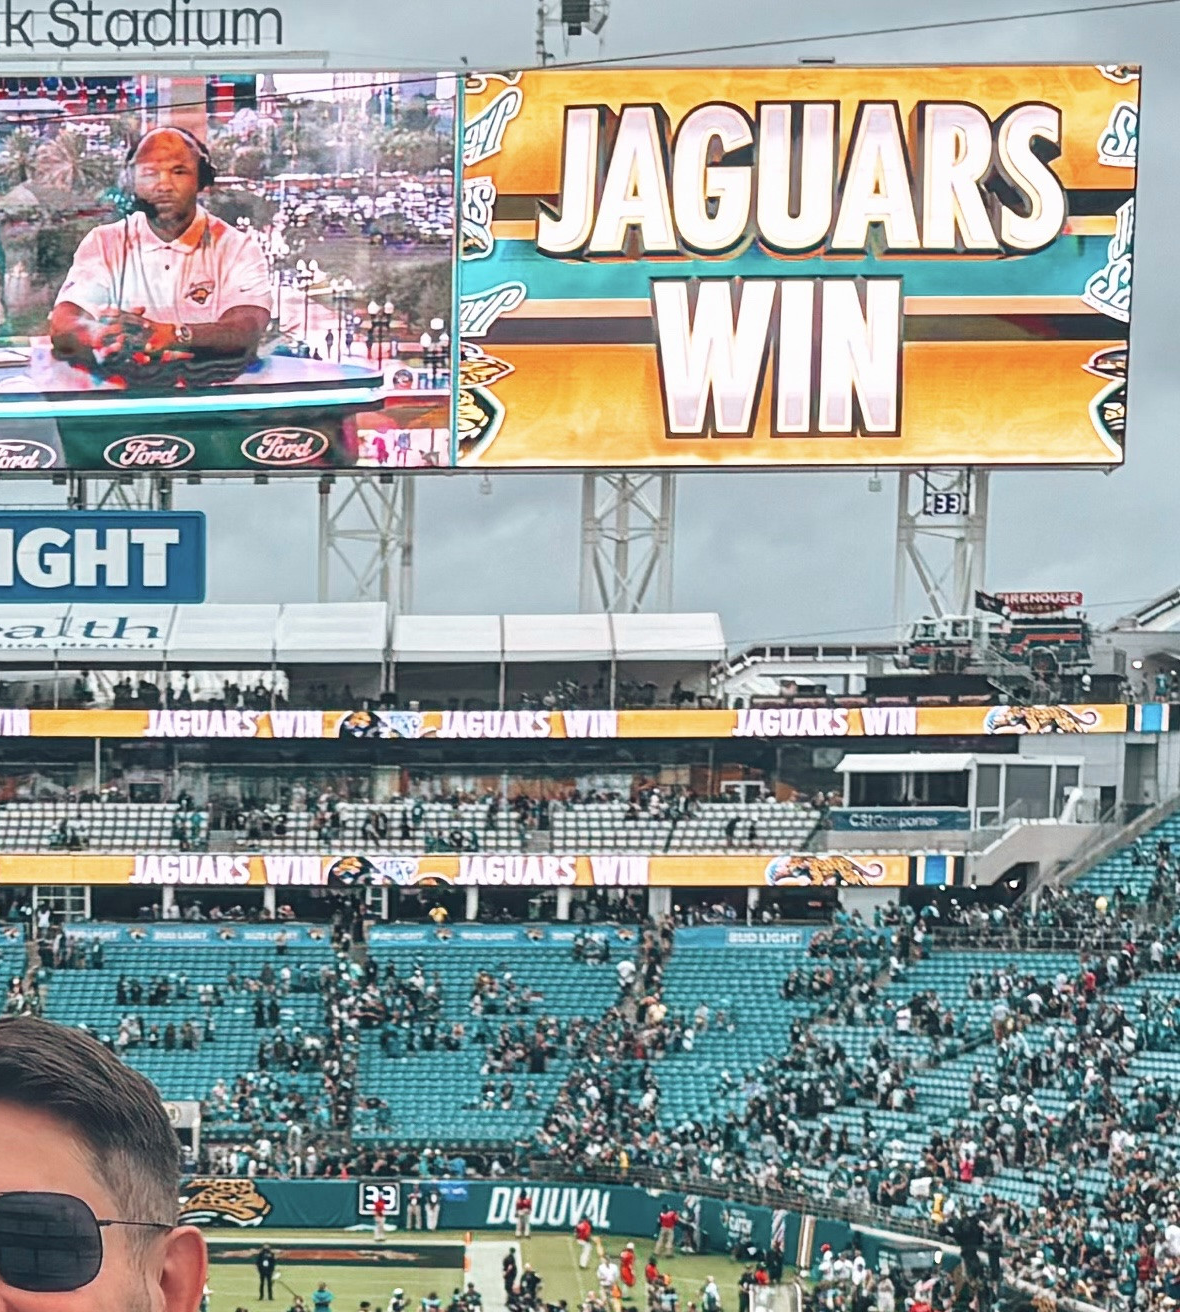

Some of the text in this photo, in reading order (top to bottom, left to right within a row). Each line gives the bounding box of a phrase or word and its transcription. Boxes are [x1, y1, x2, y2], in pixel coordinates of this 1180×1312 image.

[46, 0, 283, 49] Stadium
[537, 100, 1067, 257] JAGUARS
[650, 275, 903, 438] WIN
[120, 439, 178, 467] Ford
[257, 432, 313, 459] Ford
[935, 494, 961, 513] 33
[143, 710, 321, 738] JAGUARS WIN
[436, 709, 617, 738] JAGUARS WIN
[732, 707, 918, 738] JAGUARS WIN
[128, 855, 323, 886] JAGUARS WIN
[453, 855, 650, 886] JAGUARS WIN
[729, 932, 800, 945] BUD LIGHT
[366, 1185, 396, 1210] 33
